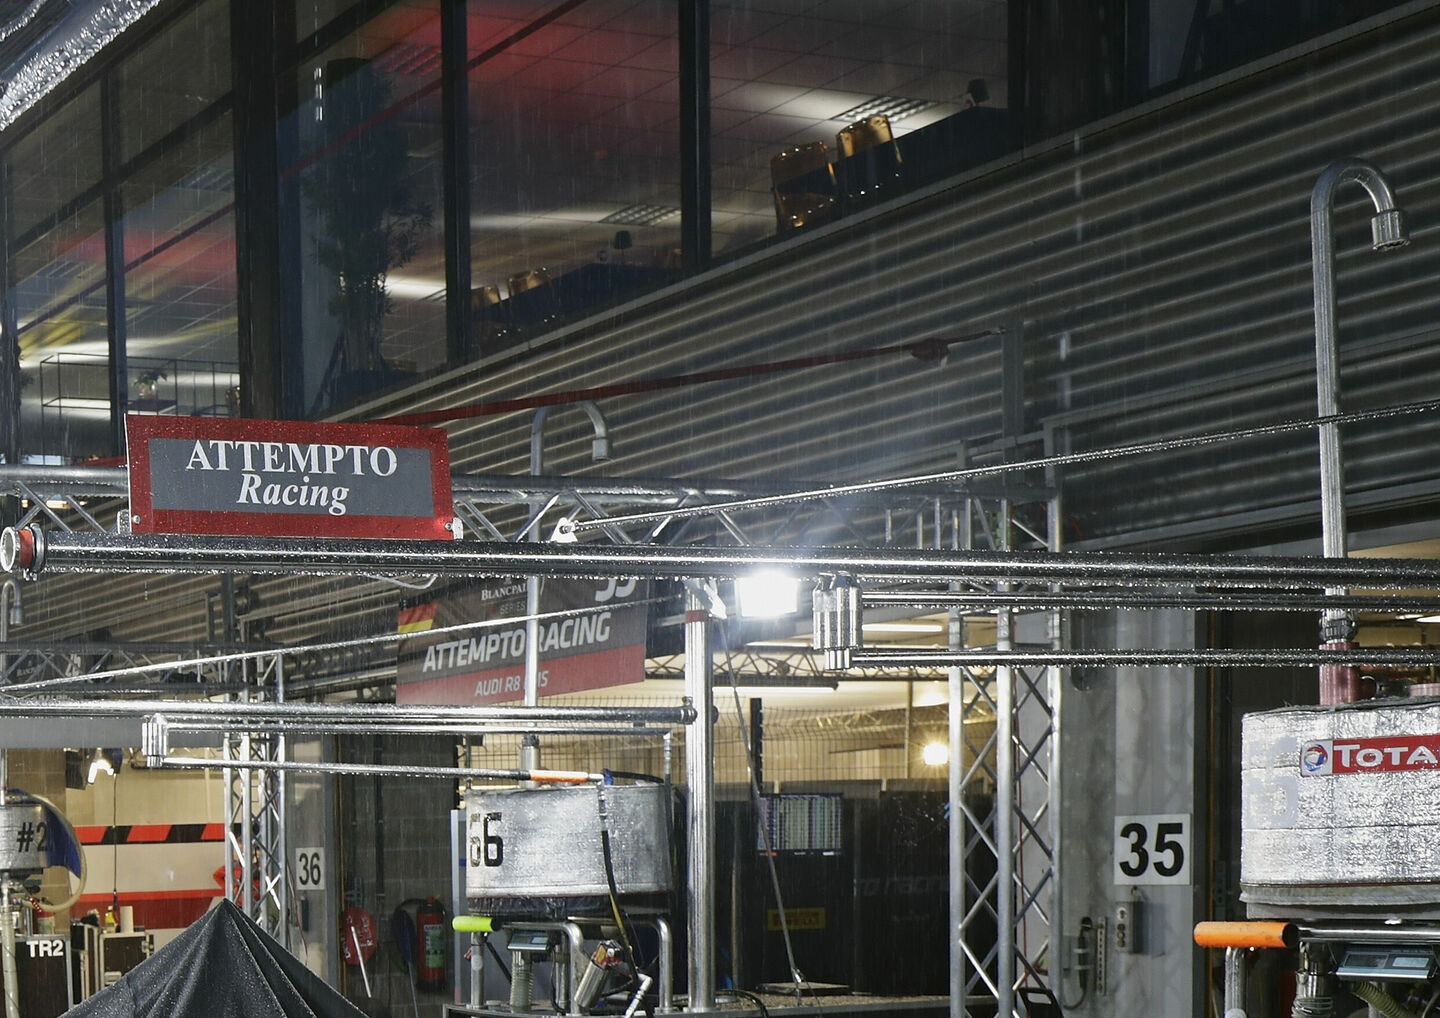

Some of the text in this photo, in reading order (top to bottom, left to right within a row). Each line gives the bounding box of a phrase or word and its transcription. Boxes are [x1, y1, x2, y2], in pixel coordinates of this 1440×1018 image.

[185, 439, 398, 477] ATTEMPTO
[236, 473, 350, 516] Racing
[481, 583, 527, 601] BLANCPAI
[422, 629, 527, 673] ATTEMPTO
[474, 678, 502, 697] AUDI
[504, 675, 521, 692] R8
[1333, 744, 1440, 768] TOTA
[16, 822, 47, 852] #2
[1119, 823, 1185, 877] 35
[299, 852, 321, 885] 36
[26, 940, 64, 957] TR2
